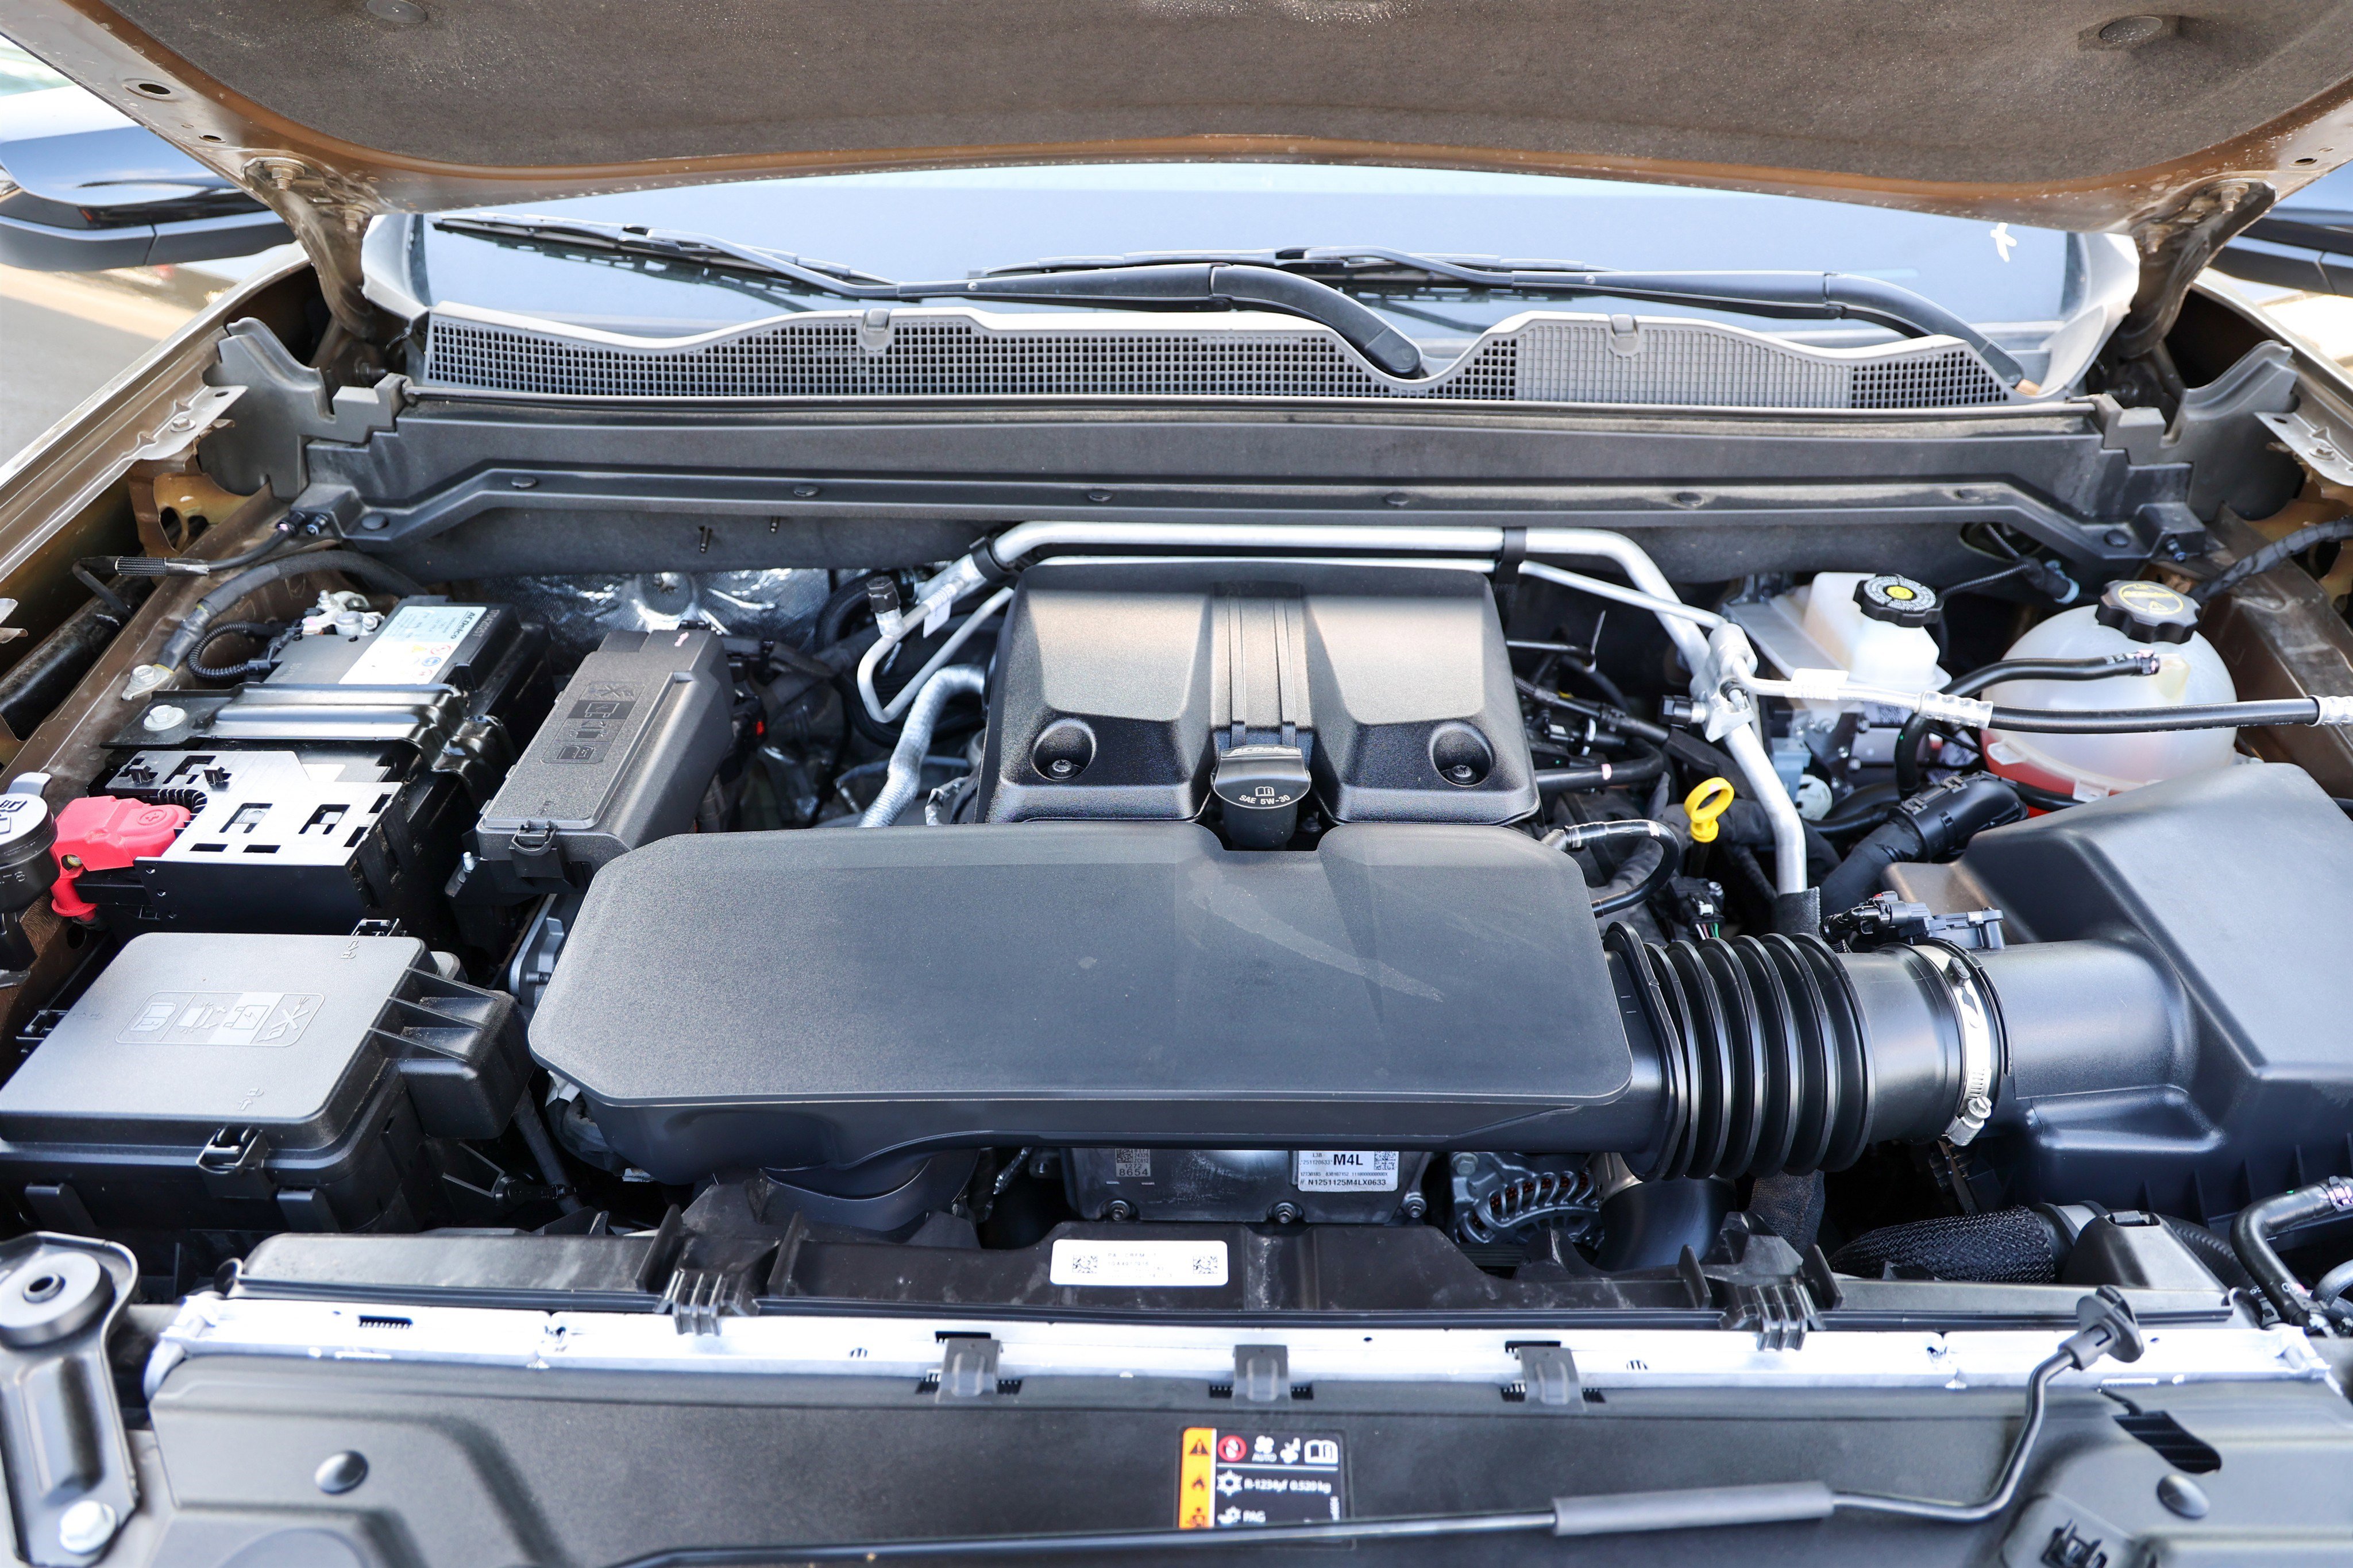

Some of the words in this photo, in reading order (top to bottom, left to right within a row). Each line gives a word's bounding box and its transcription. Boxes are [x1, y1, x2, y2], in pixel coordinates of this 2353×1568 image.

[450, 612, 475, 639] ACDelco
[1229, 747, 1298, 755] ACDelco
[1239, 794, 1257, 804] SAE
[1260, 794, 1291, 805] 5W-30
[1333, 1154, 1363, 1165] M4L
[1119, 1168, 1148, 1176] 8654
[1252, 1453, 1277, 1462] AUTO
